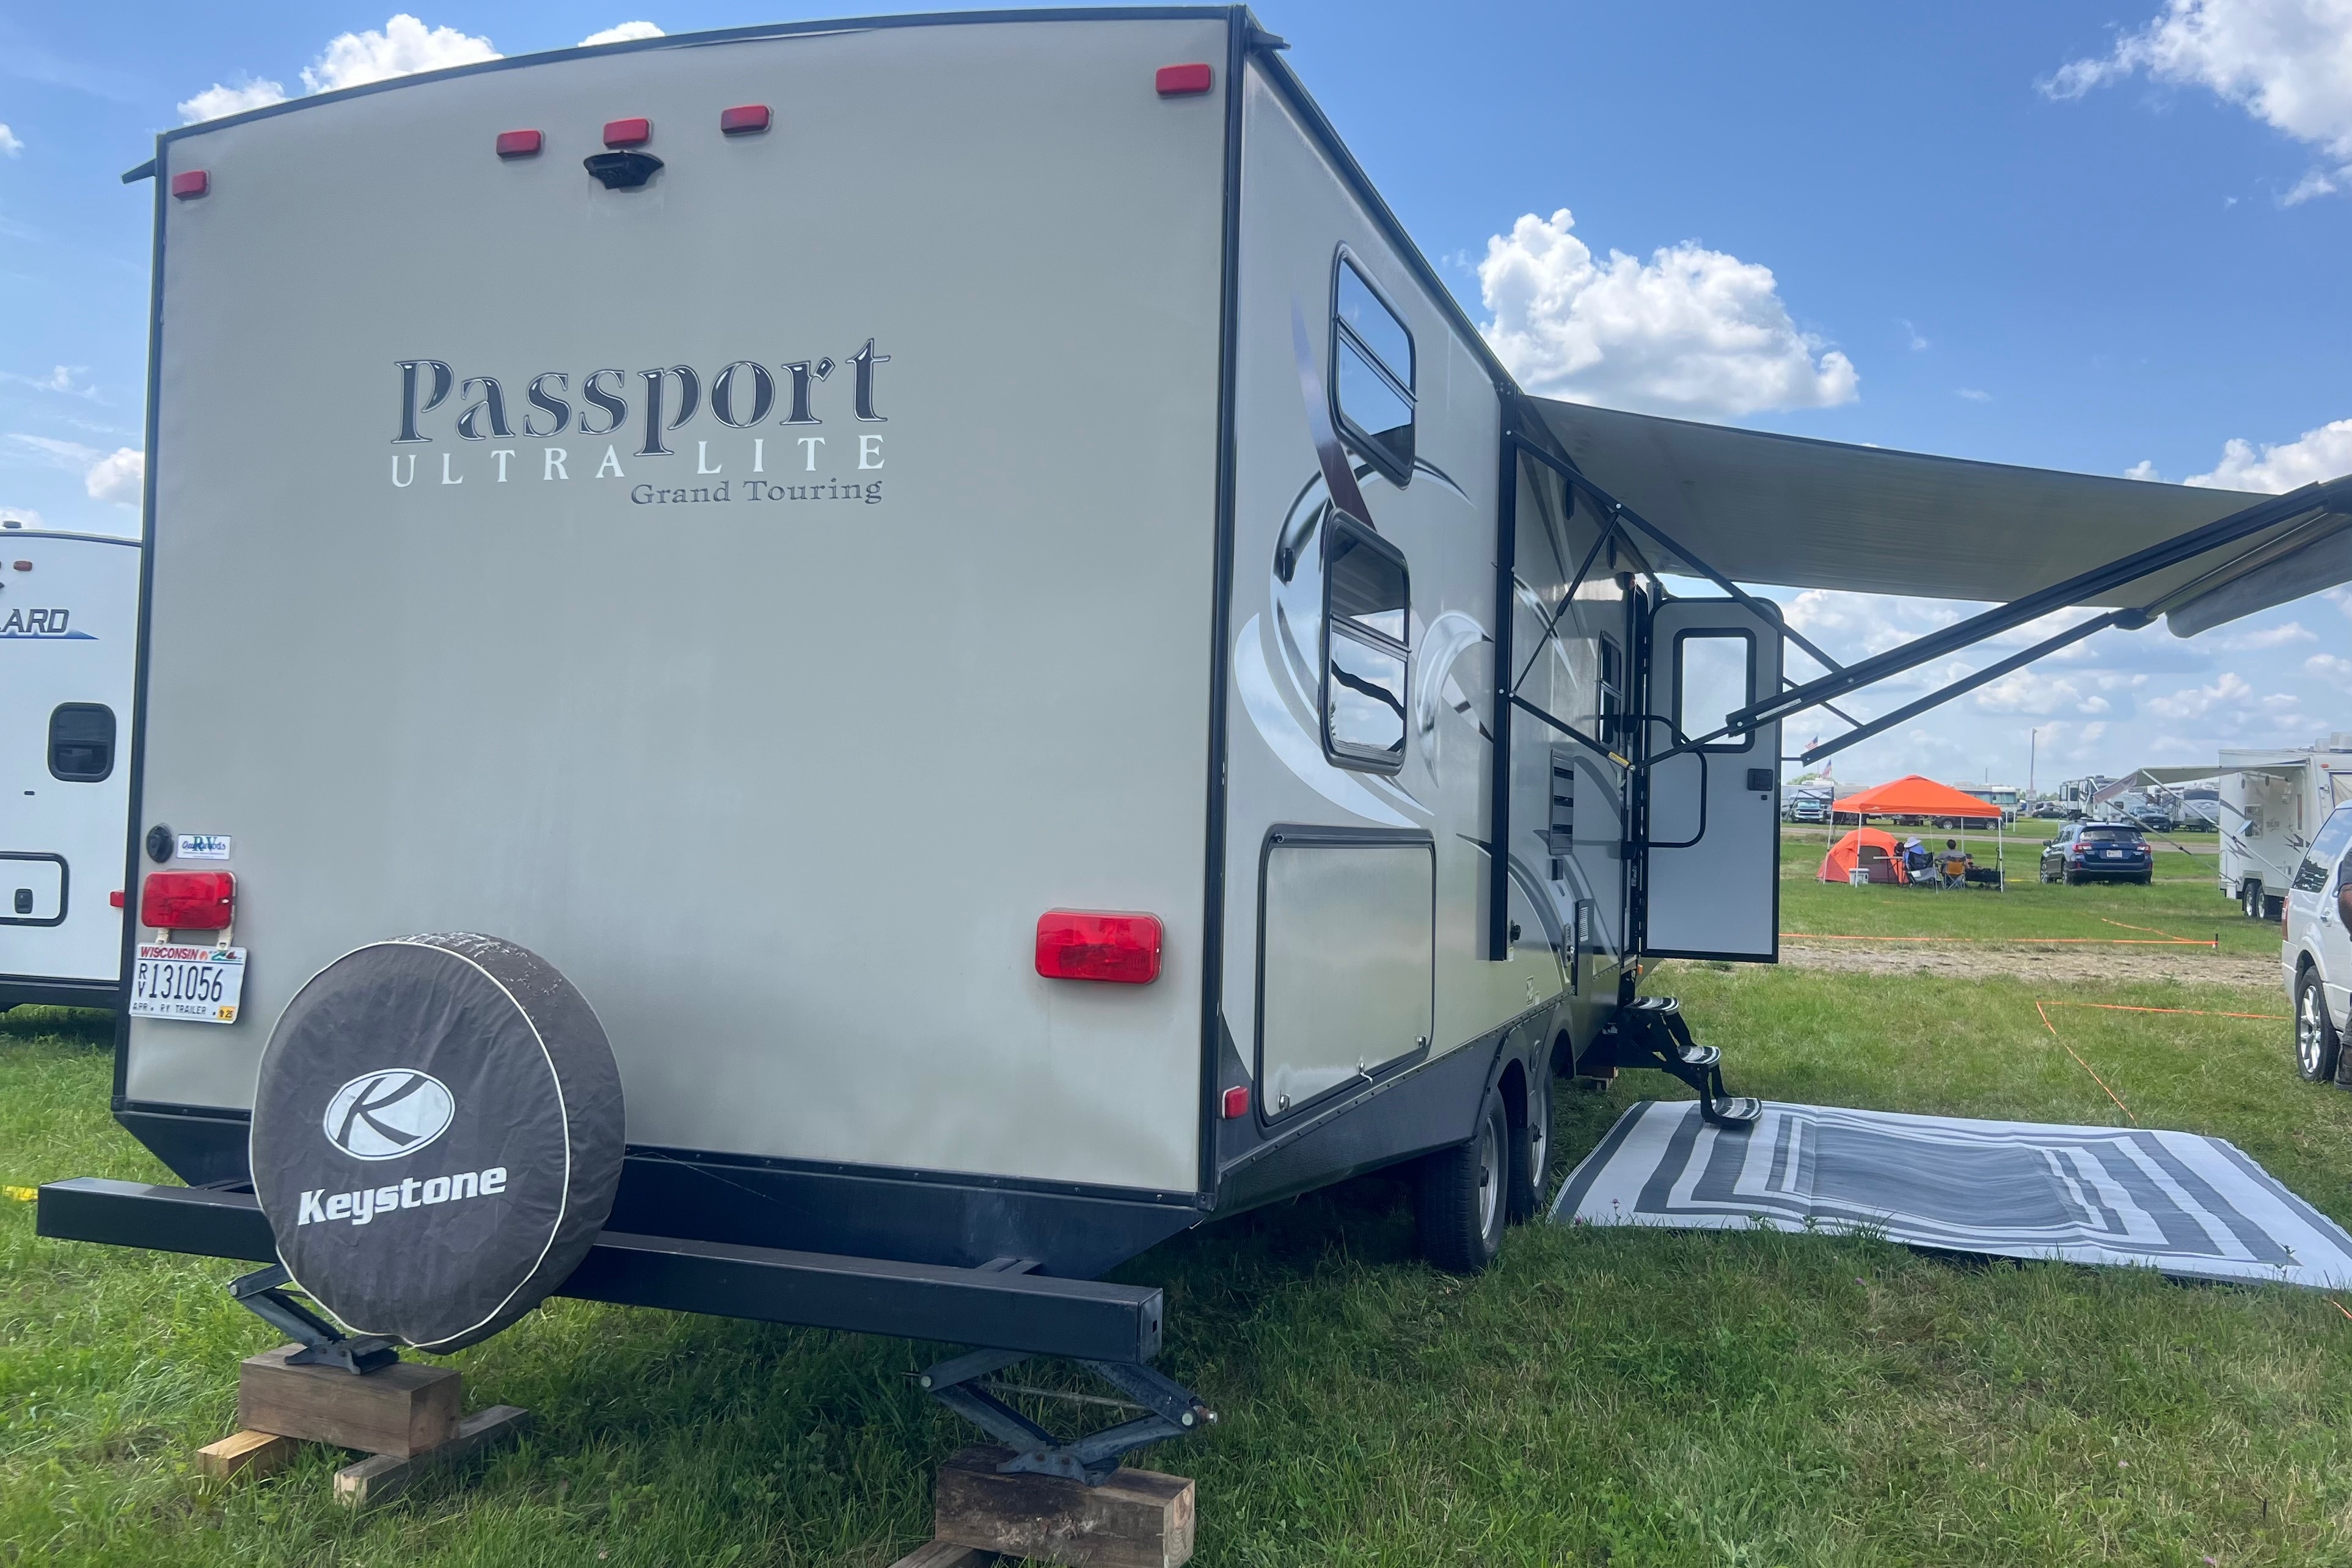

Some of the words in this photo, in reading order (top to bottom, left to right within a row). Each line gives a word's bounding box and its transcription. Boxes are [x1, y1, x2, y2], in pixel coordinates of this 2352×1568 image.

[390, 337, 891, 457] Passport
[391, 445, 625, 487] ULTRA
[696, 434, 885, 475] LITE
[630, 480, 732, 505] Grand
[743, 478, 883, 505] Touring
[0, 608, 70, 633] ARD
[141, 946, 199, 960] WISCONSIN
[149, 963, 224, 1002] 131056
[175, 1005, 206, 1015] TRAILER
[297, 1166, 508, 1226] Keystone
